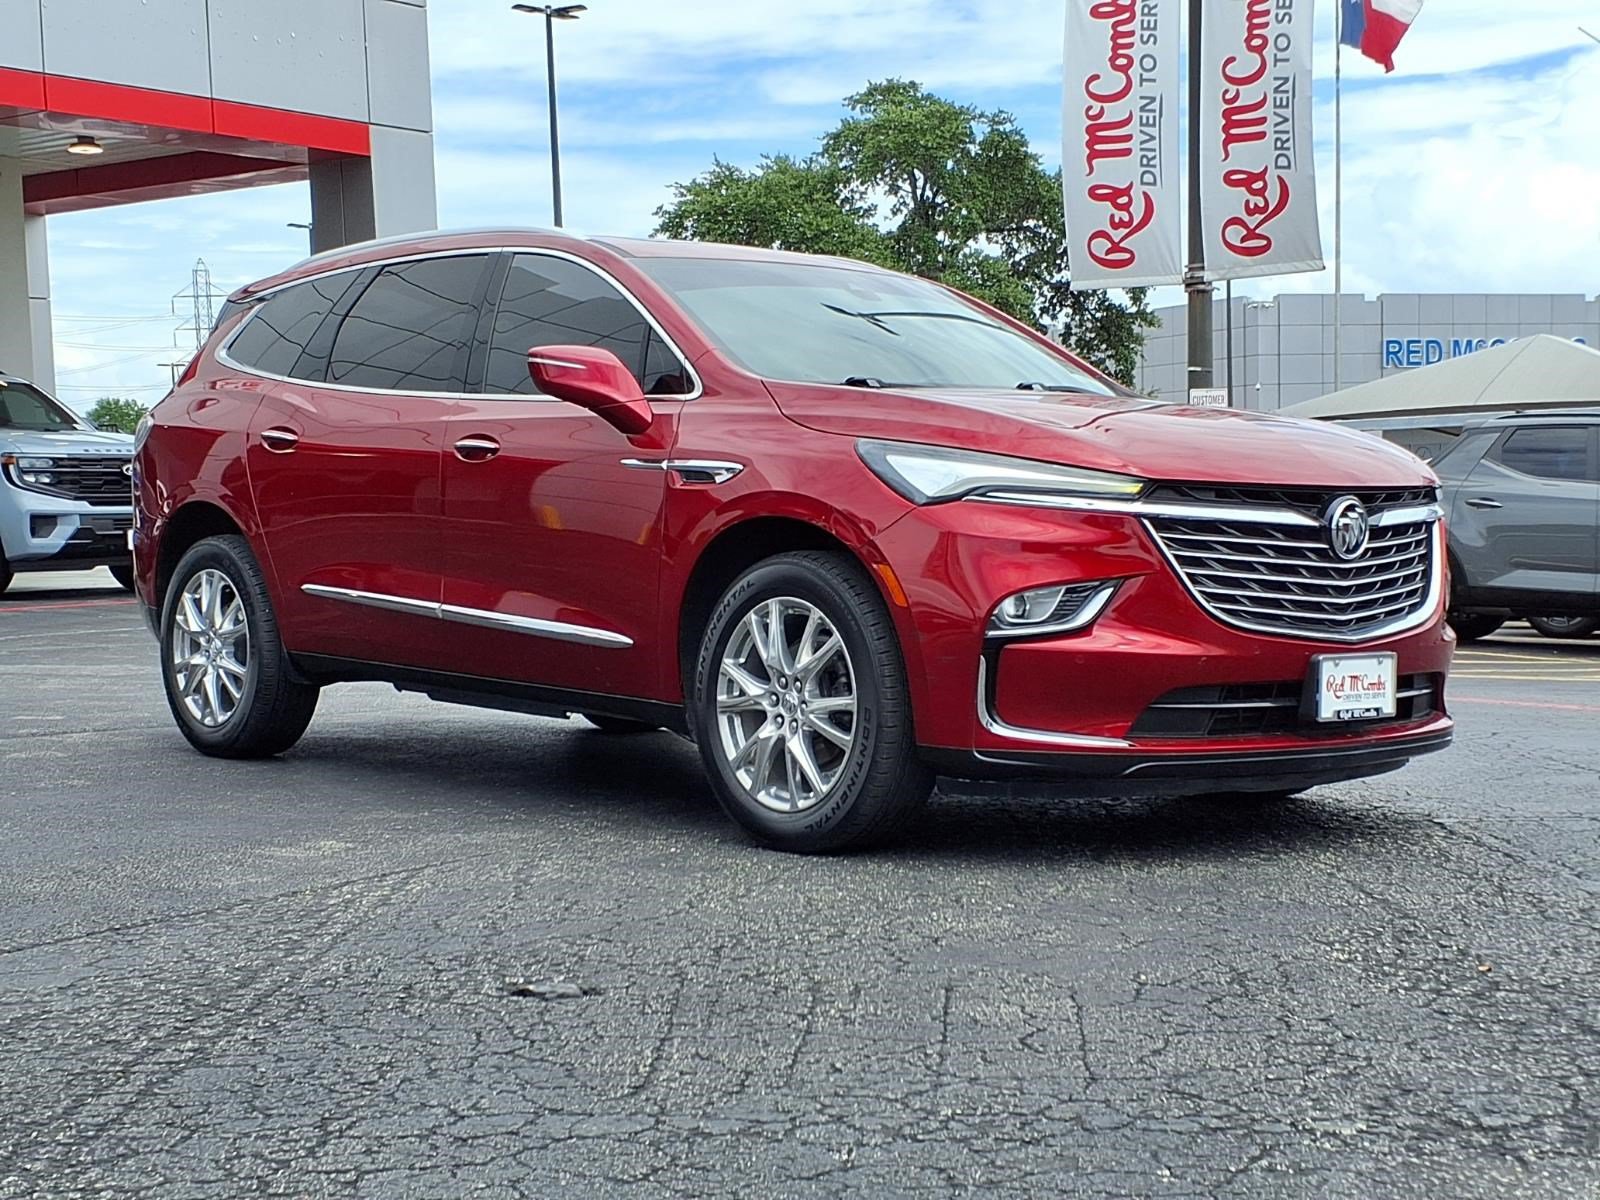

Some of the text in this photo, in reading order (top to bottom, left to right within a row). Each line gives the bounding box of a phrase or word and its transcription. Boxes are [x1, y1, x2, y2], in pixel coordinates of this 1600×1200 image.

[1139, 0, 1158, 187] DRIVEN TO SER
[1273, 32, 1292, 67] TO
[1084, 0, 1155, 270] Red McComb
[1220, 0, 1290, 257] Red McCom
[1273, 76, 1292, 170] DRIVEN
[1192, 394, 1225, 406] CUSTOMER
[1384, 338, 1443, 367] RED
[696, 581, 756, 703] CONTINENTAL
[1326, 673, 1346, 700] Red
[804, 706, 871, 834] CONTINENTAL
